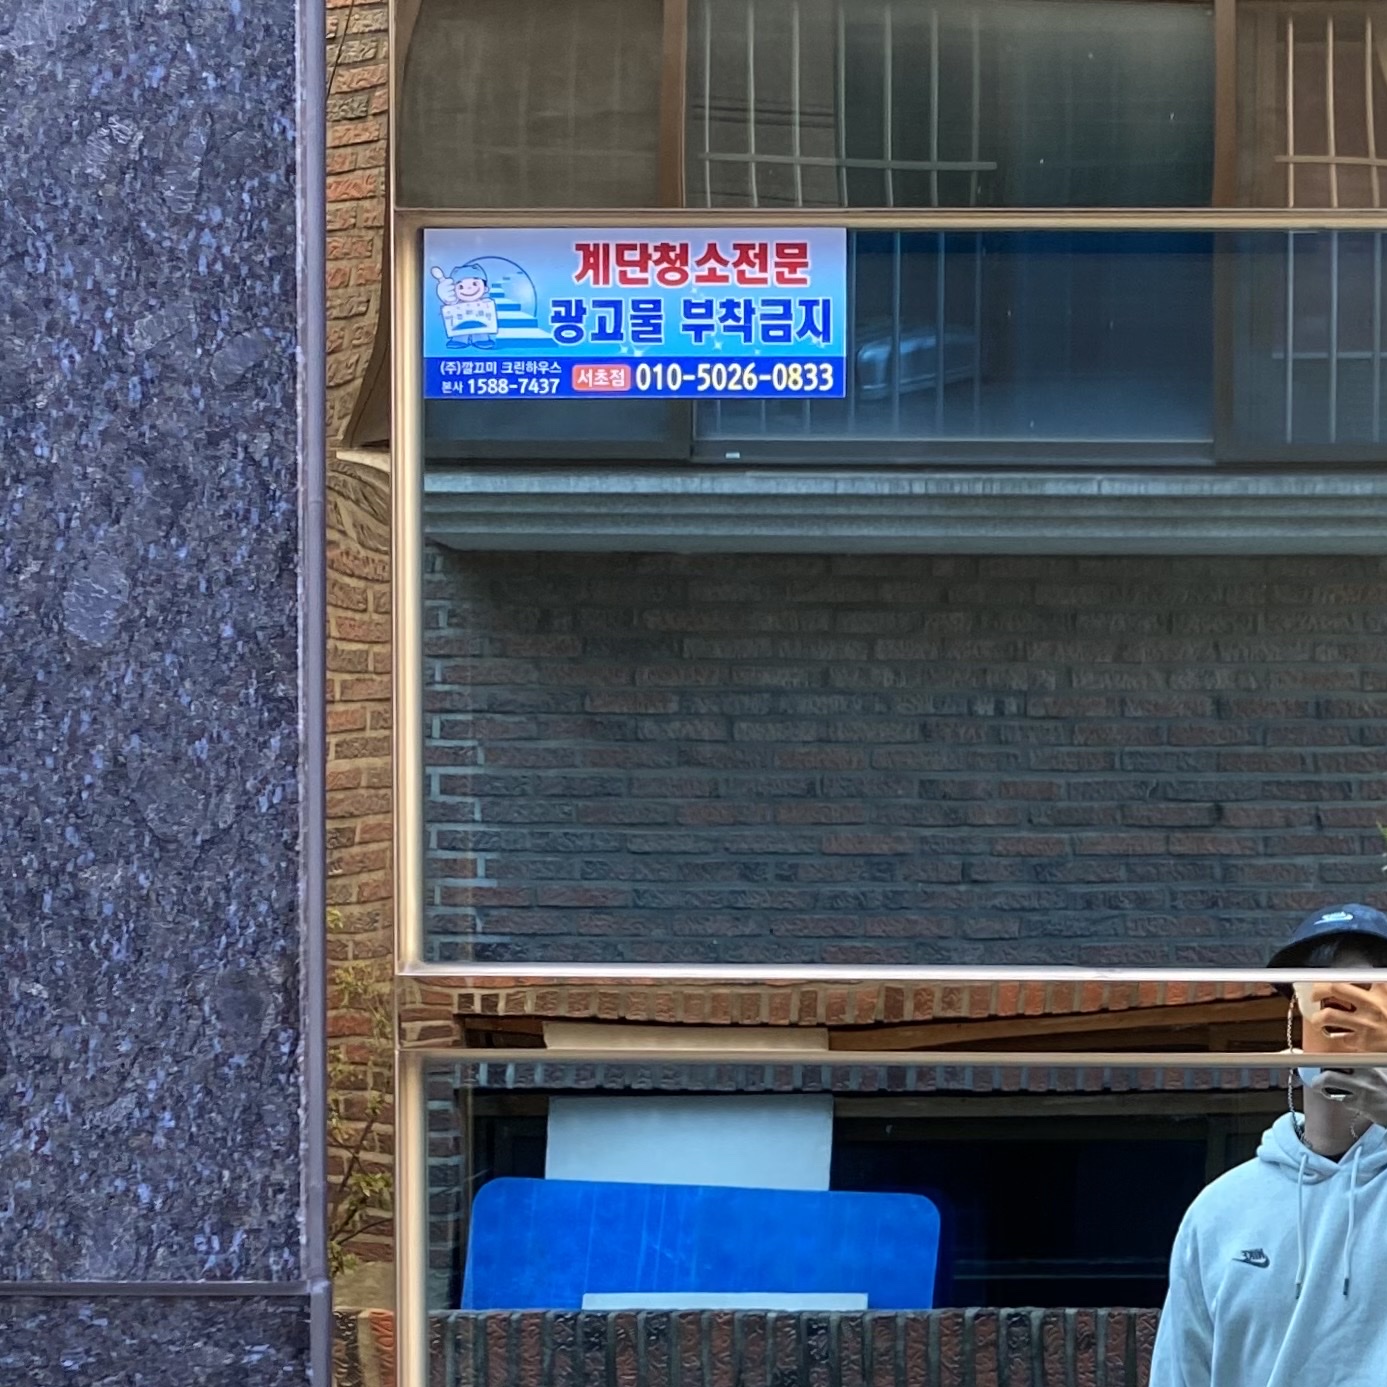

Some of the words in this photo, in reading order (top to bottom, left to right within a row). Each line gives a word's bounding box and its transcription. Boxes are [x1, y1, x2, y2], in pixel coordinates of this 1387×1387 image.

[574, 241, 809, 285] 계단청소전문
[550, 298, 664, 344] 광고물
[682, 298, 832, 344] 부착금지
[501, 361, 562, 375] 크린하우스
[578, 367, 625, 387] 서초점
[635, 363, 834, 392] 010-5026-0833
[442, 380, 463, 394] 본사
[468, 378, 560, 395] 1588-7437
